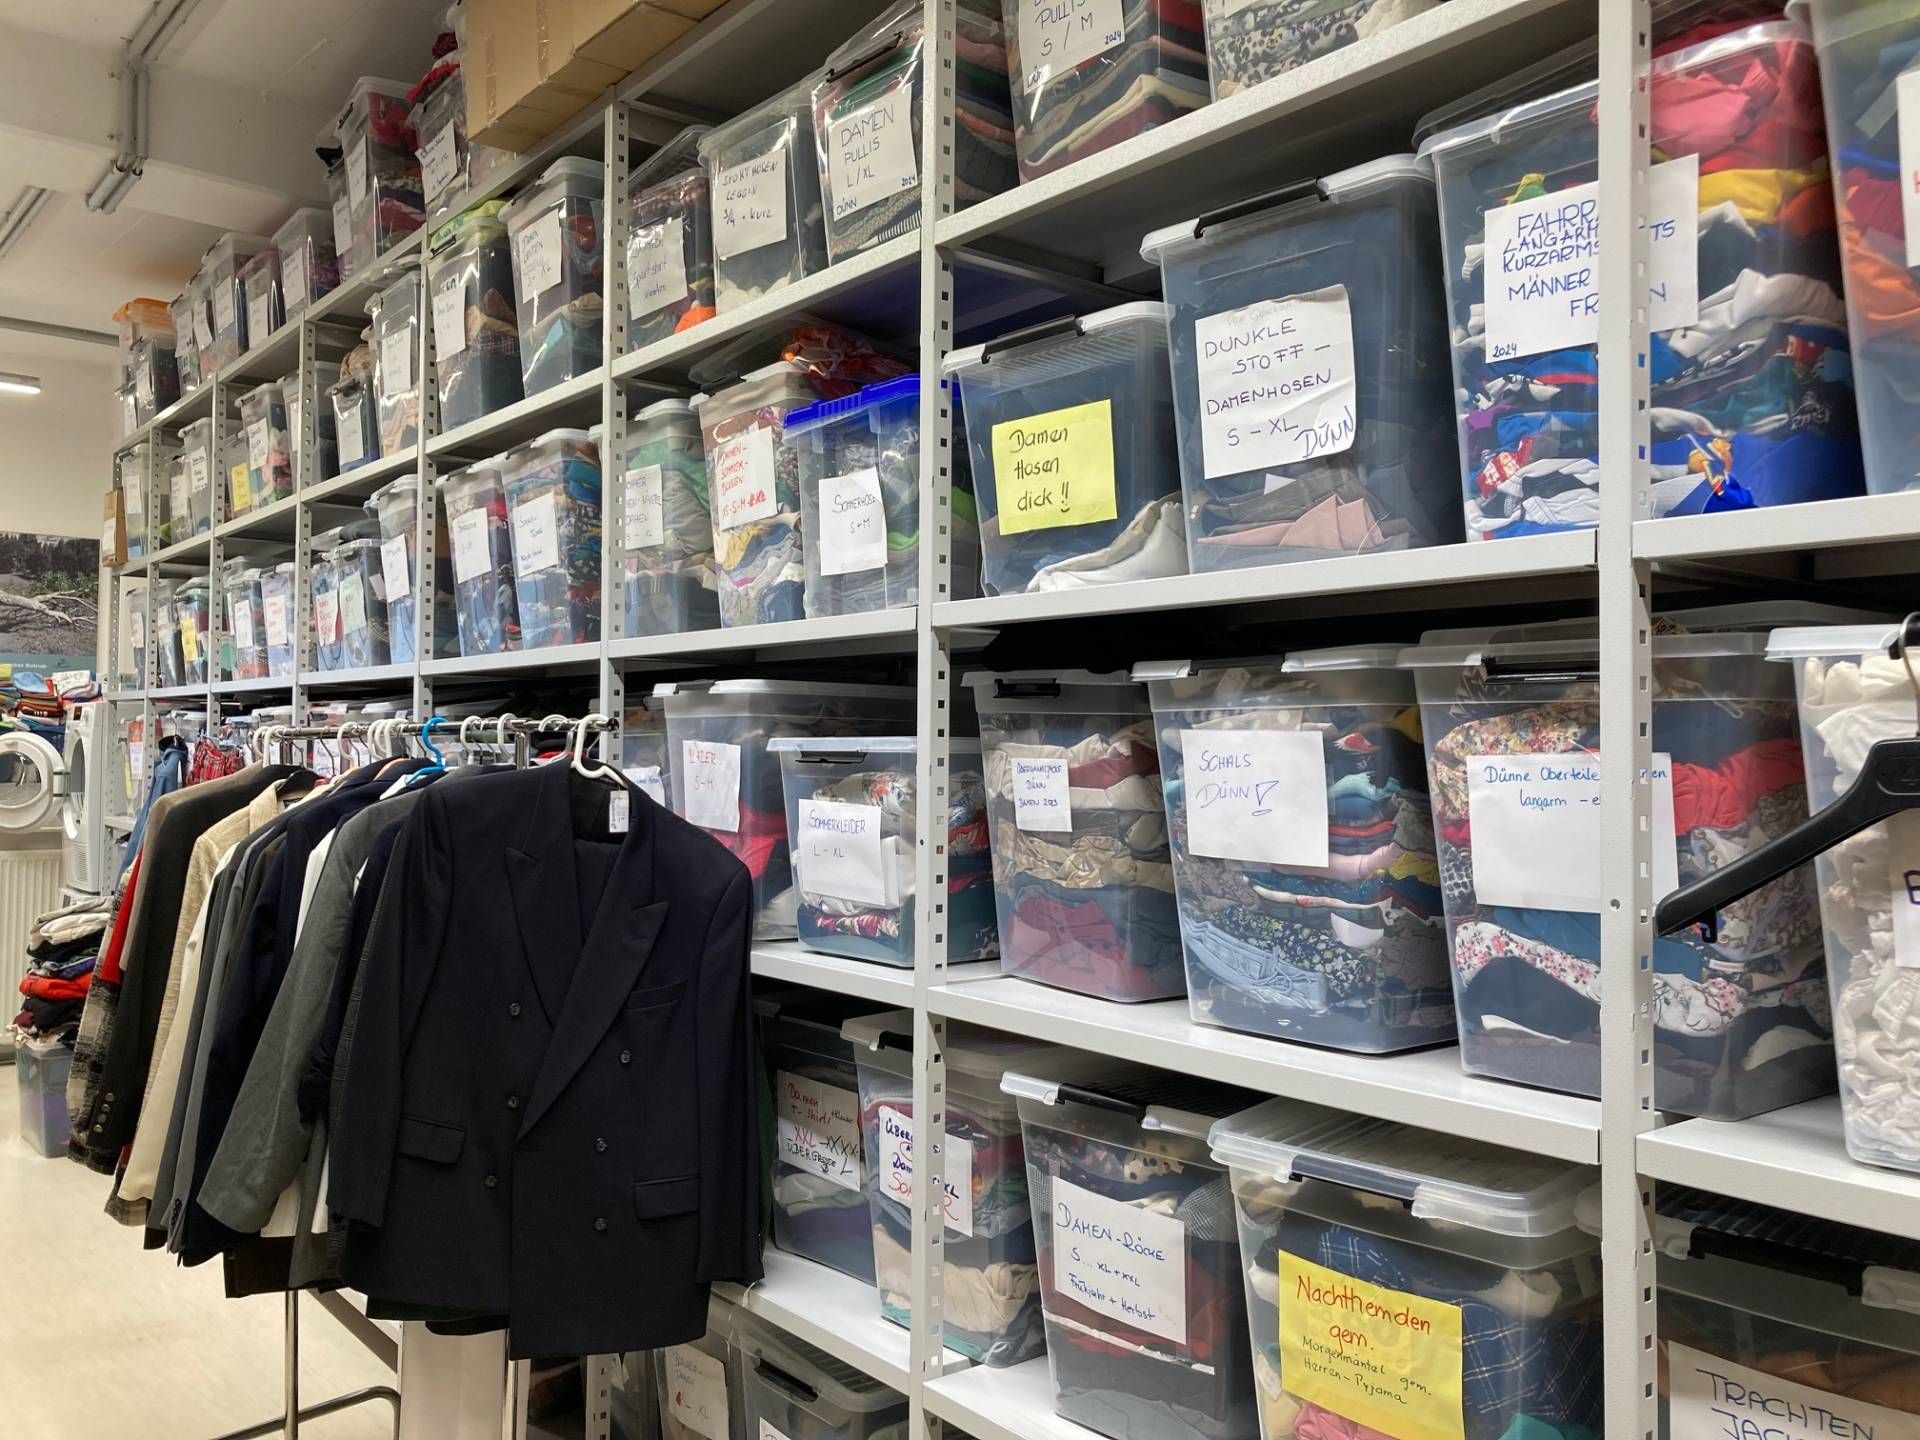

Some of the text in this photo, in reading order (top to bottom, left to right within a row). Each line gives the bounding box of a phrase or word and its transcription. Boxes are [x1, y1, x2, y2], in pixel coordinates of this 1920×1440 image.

[1041, 38, 1053, 57] S
[1081, 13, 1094, 31] M
[1104, 31, 1122, 45] 2024
[841, 103, 895, 148] DAMEN
[844, 136, 880, 165] PULLIS
[1508, 267, 1591, 301] MÄNNER
[1205, 318, 1297, 359] DUNKLE
[1492, 343, 1517, 358] 2024
[1231, 344, 1304, 376] STOFF
[1207, 368, 1332, 416] DAMENHOSEN
[1009, 427, 1069, 454] Damen
[1227, 428, 1240, 447] S
[1269, 417, 1299, 436] XL
[1294, 404, 1354, 459] DÜNN
[1014, 456, 1060, 480] Hosen
[1017, 487, 1053, 512] dick
[1199, 750, 1252, 772] SCHALS
[1485, 766, 1532, 784] Dünne
[1520, 789, 1568, 812] langarm
[1297, 1275, 1431, 1335] Nachthemden
[1330, 1325, 1374, 1353] gem.
[1695, 1368, 1873, 1440] TRACHTEN
